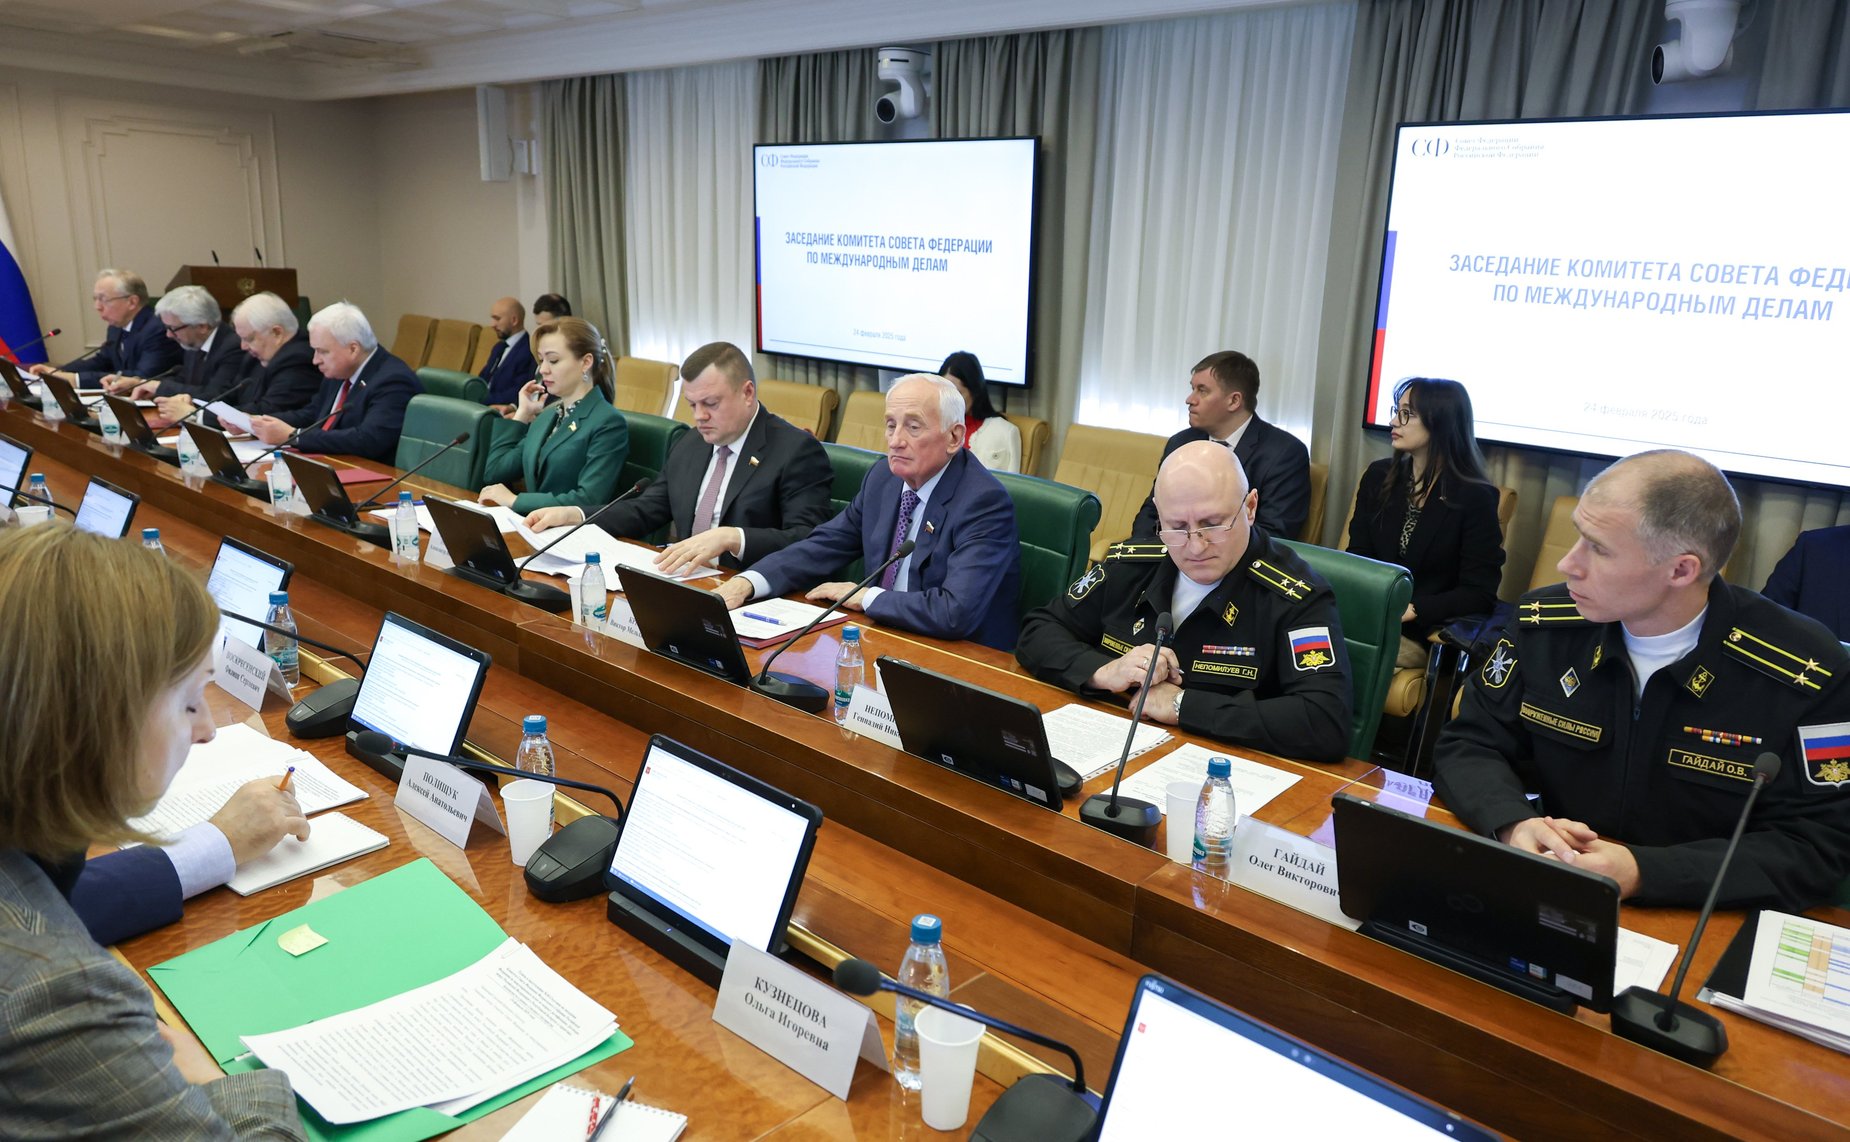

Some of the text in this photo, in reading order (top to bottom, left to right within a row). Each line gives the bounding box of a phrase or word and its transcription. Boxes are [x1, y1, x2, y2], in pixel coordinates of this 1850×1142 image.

[785, 231, 993, 255] ЗАСЕДАНИЕ КОМИТЕТА СОВЕТА ФЕДЕРАЦИИ
[806, 251, 948, 272] ПО МЕЖДУНАРОДНЫМ ДЕЛАМ
[1449, 254, 1562, 277] ЗАСЕДАНИЕ
[1567, 258, 1682, 281] КОМИТЕТА
[1690, 263, 1780, 286] СОВЕТА
[1493, 284, 1834, 321] ПО МЕЖДУНАРОДНЫМ ДЕЛАМ
[1650, 409, 1679, 422] 2025
[1681, 414, 1708, 425] года
[1194, 663, 1240, 674] НЕПОМИЛУЕВ
[853, 712, 900, 737] Геннадий Ник
[864, 704, 895, 723] НЕПОМ
[1682, 755, 1748, 777] ГАЙДАЙ О.В.
[422, 771, 459, 800] ПОЛИЩУК
[406, 778, 468, 822] Алексей Анатольевич
[1248, 854, 1276, 872] Олег
[1273, 847, 1326, 876] ГАЙДАЙ
[754, 975, 827, 1029] КУЗНЕЦОВА
[744, 991, 830, 1052] Ольга Игоревна
